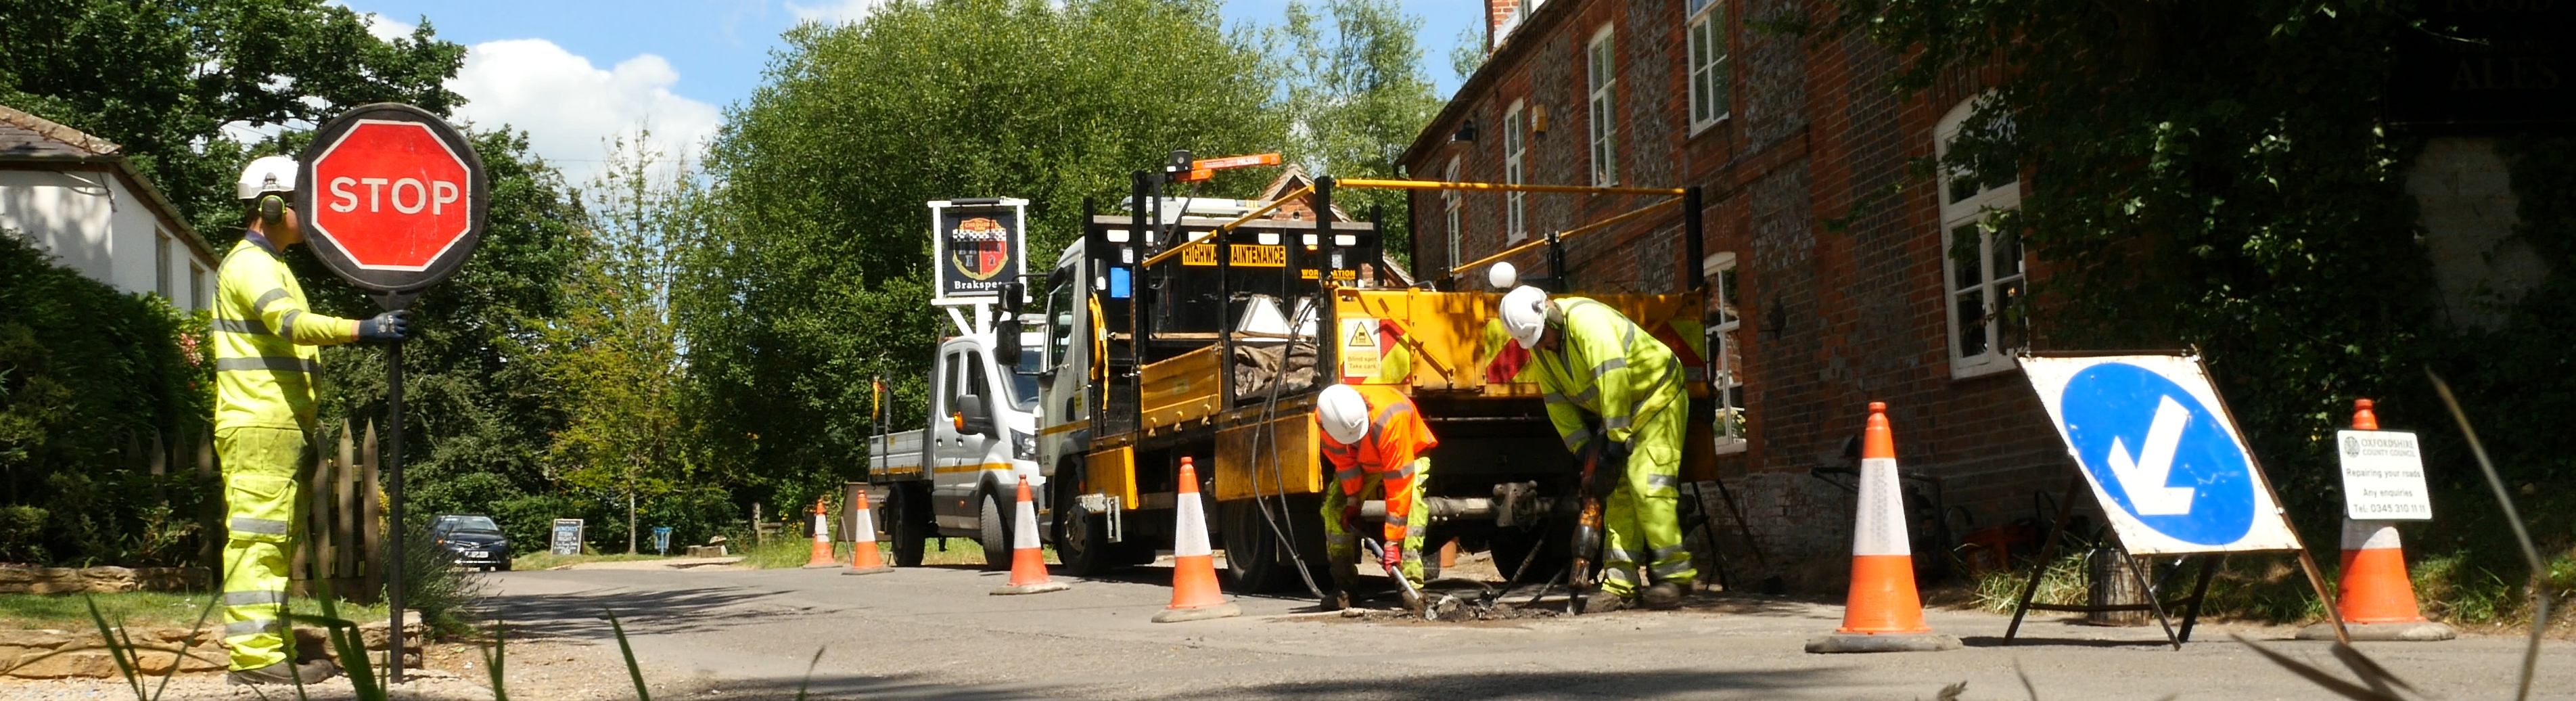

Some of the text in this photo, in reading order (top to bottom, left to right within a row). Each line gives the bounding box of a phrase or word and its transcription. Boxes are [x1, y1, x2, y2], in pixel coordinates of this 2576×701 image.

[329, 177, 459, 215] STOP
[1185, 245, 1284, 264] HIGHWA AINTENANCE
[954, 280, 1000, 291] Brakspe
[2361, 438, 2415, 449] OXFORDSHIRE
[2362, 449, 2416, 457] COUNTY COUNCIL
[2346, 468, 2421, 478] Repairing your roads
[2363, 488, 2413, 498] Any enquiries
[2370, 503, 2393, 513] 0345
[2395, 503, 2409, 513] 310
[2411, 504, 2418, 513] 11
[2419, 504, 2426, 513] 11
